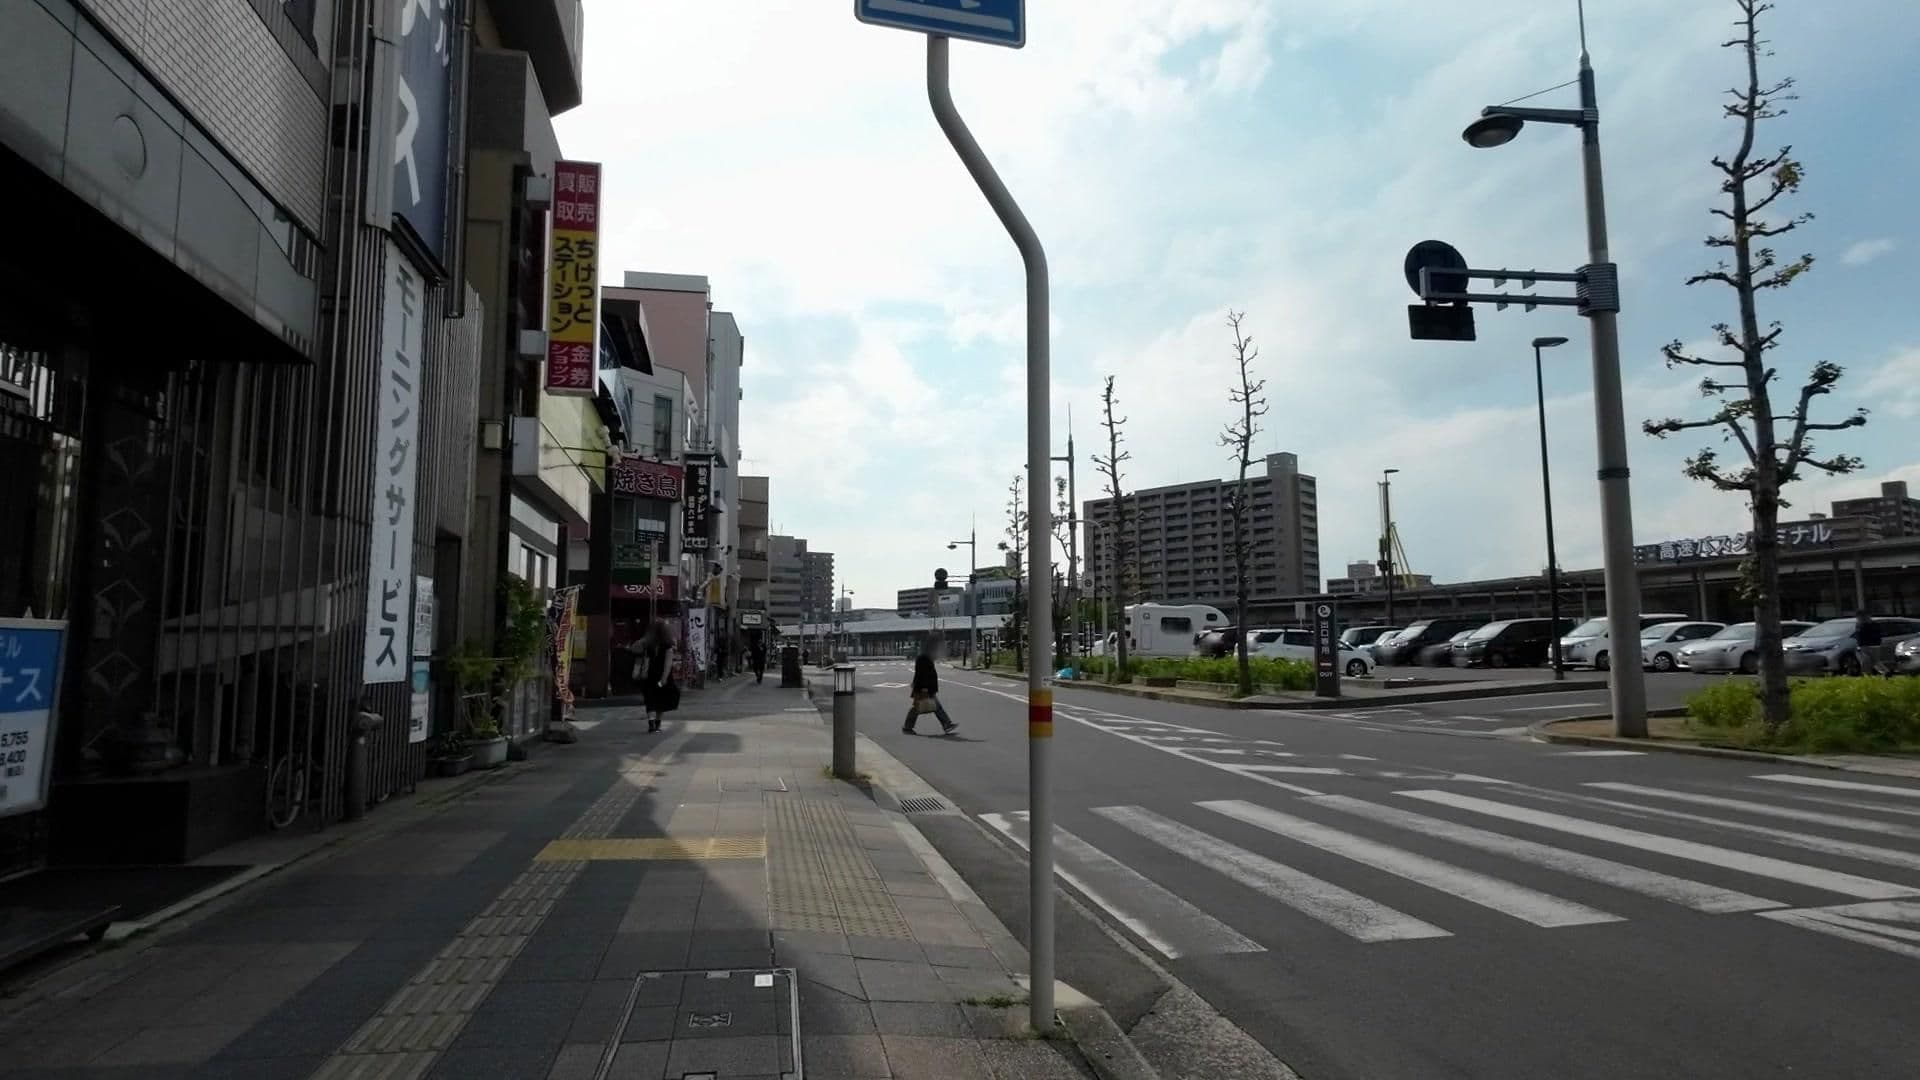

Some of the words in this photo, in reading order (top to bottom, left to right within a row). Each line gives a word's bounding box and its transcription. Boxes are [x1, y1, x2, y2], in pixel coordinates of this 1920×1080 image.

[556, 171, 576, 222] 買取
[576, 173, 597, 223] 販売
[551, 236, 576, 334] ステーション
[573, 237, 596, 325] ちけっと
[551, 343, 571, 385] ショップ
[569, 345, 592, 387] 金券
[375, 262, 416, 668] モーニングサービス
[612, 468, 678, 500] 焼き鳥
[1659, 523, 1833, 560] 高速バスタミナル
